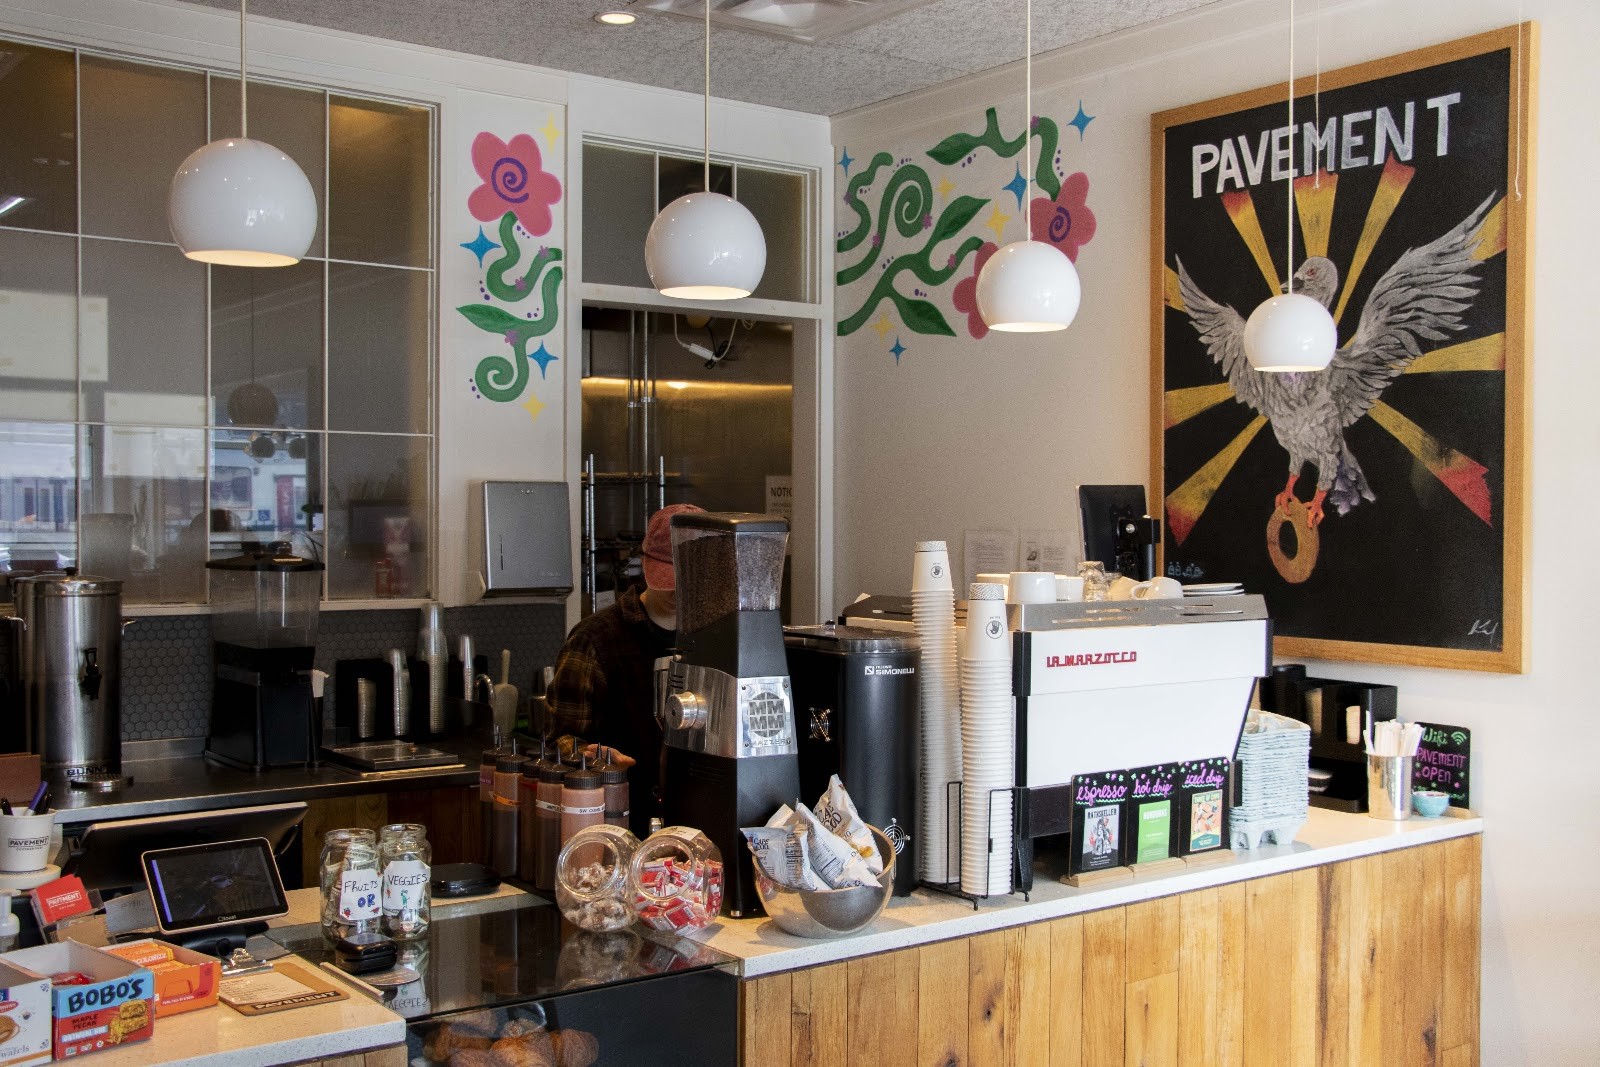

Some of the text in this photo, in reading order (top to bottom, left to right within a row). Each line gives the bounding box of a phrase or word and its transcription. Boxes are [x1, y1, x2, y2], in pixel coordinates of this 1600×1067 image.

[1192, 92, 1461, 199] PAVEMENT
[1064, 651, 1137, 667] MARZOCCO
[1416, 748, 1467, 769] PAVEMENT
[67, 766, 103, 776] BUNN
[1184, 768, 1224, 789] iced drip
[1421, 766, 1451, 784] OPEN
[1076, 784, 1128, 807] espresso
[1133, 777, 1173, 798] hot drip
[1087, 808, 1117, 820] RATHSKELLER
[10, 837, 48, 846] PAVEMENT
[387, 873, 428, 887] VEGGIES
[47, 893, 81, 906] PAVEMENT
[357, 893, 376, 909] OR
[67, 978, 145, 1013] BOBO'S
[254, 991, 336, 1010] PAVEMENT
[72, 1013, 99, 1025] MAPLE
